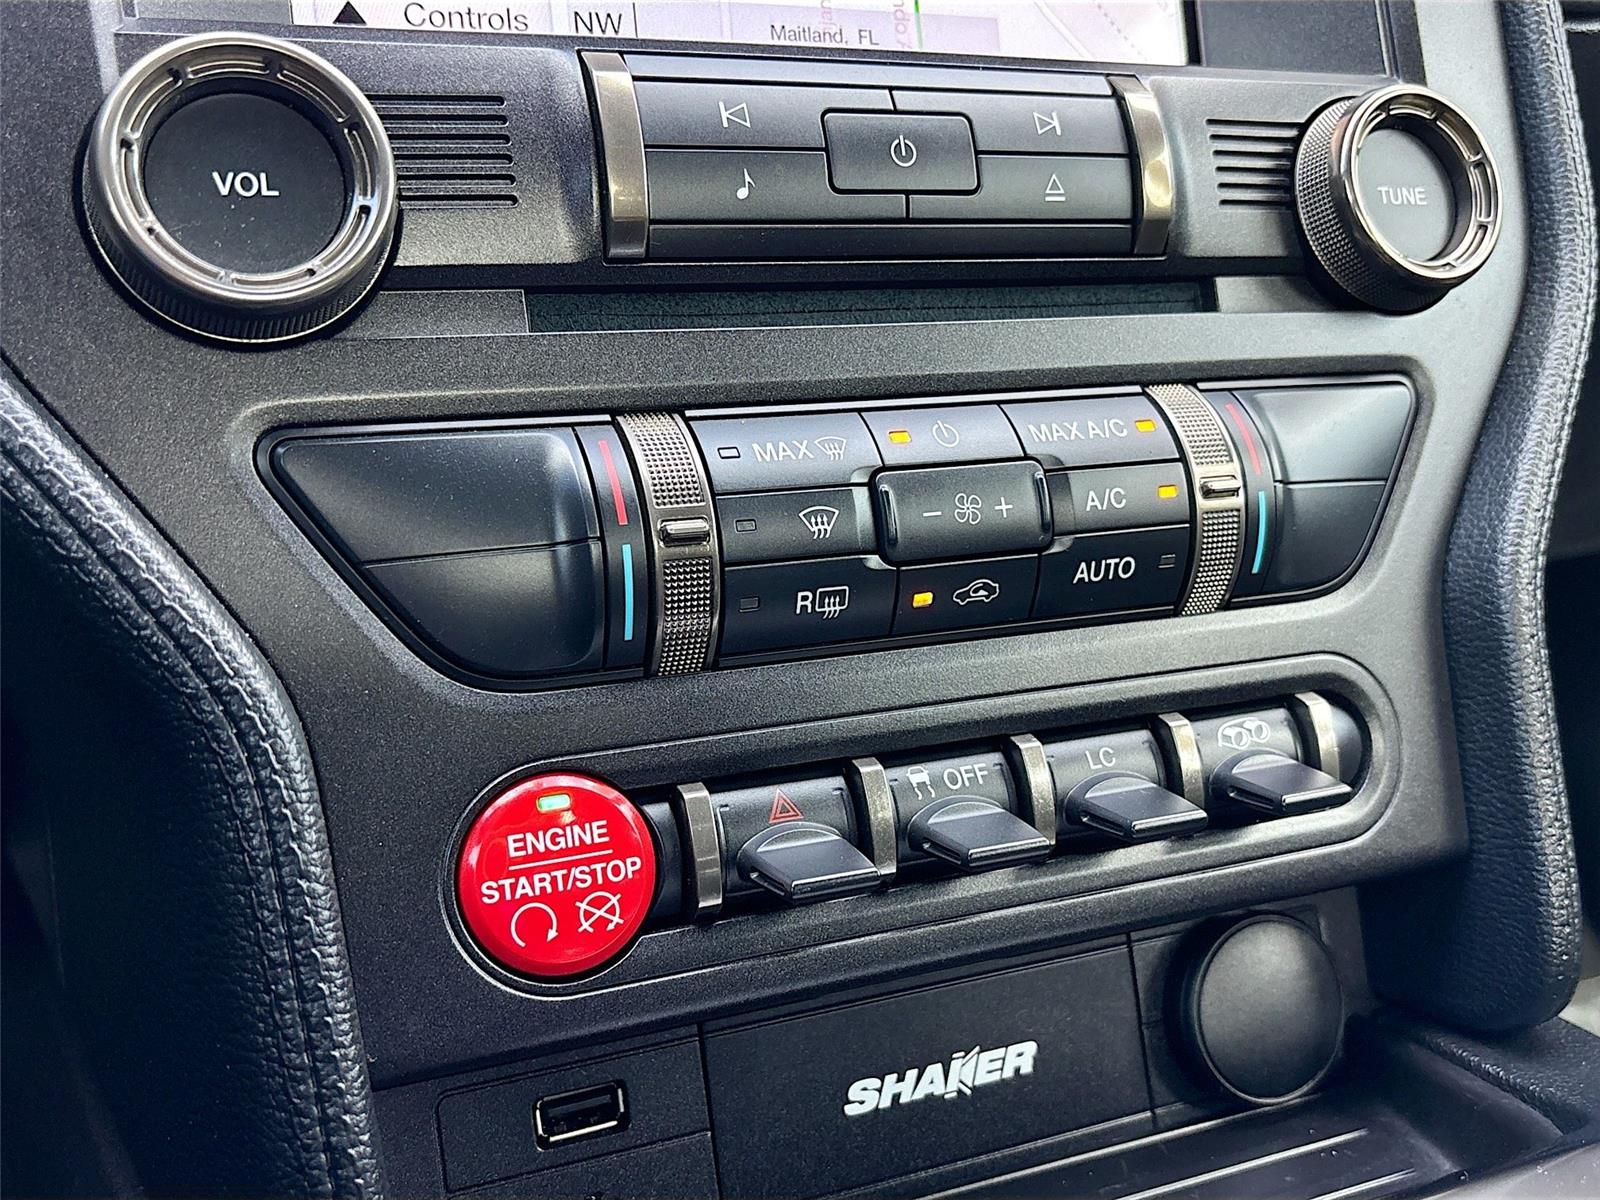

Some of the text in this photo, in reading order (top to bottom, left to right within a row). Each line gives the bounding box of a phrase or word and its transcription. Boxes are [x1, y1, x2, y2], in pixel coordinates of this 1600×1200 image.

[403, 2, 529, 32] Controls
[573, 10, 623, 35] NW
[770, 24, 880, 46] Maitland, FL
[211, 171, 280, 197] VOL
[1376, 186, 1428, 205] TUNE
[1028, 418, 1129, 443] MAX A/C
[752, 439, 815, 463] MAX
[1085, 486, 1127, 512] A/C
[1072, 556, 1137, 585] AUTO
[795, 590, 814, 615] R
[1085, 746, 1117, 770] LC
[942, 762, 989, 790] OFF
[506, 819, 611, 859] ENGINE
[480, 856, 642, 904] START/STOP
[843, 1040, 1039, 1116] SHAKER
